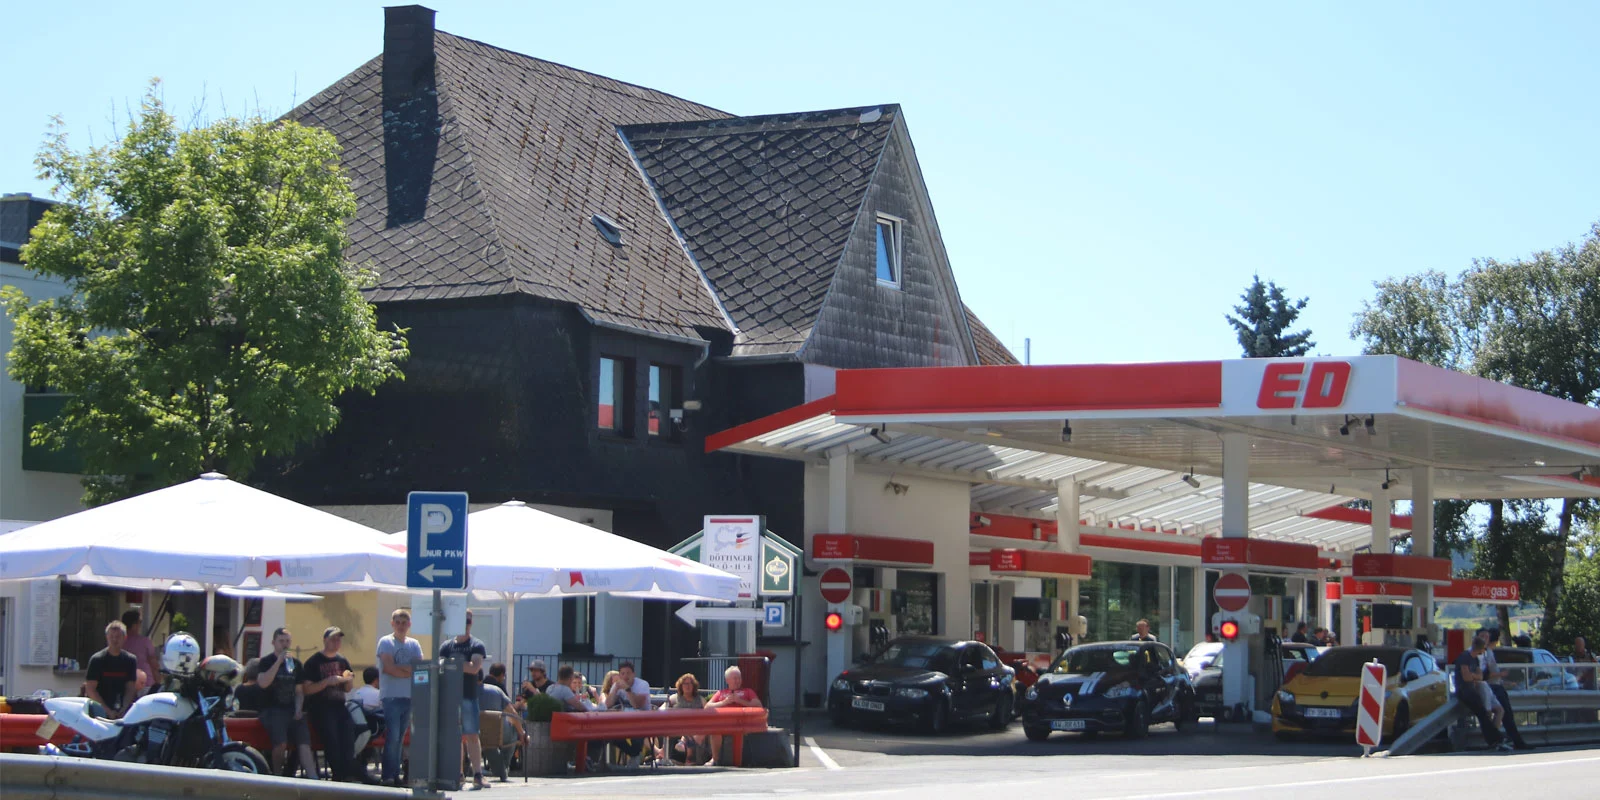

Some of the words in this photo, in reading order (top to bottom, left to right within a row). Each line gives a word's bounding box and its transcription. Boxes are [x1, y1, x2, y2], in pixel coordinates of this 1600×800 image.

[1256, 361, 1352, 409] ED
[420, 503, 453, 558] P
[426, 549, 442, 557] NUR
[444, 549, 464, 558] PKW
[709, 553, 753, 562] DÖTTINGER
[1472, 584, 1508, 599] autogas
[1510, 584, 1517, 599] 9
[769, 607, 780, 621] P
